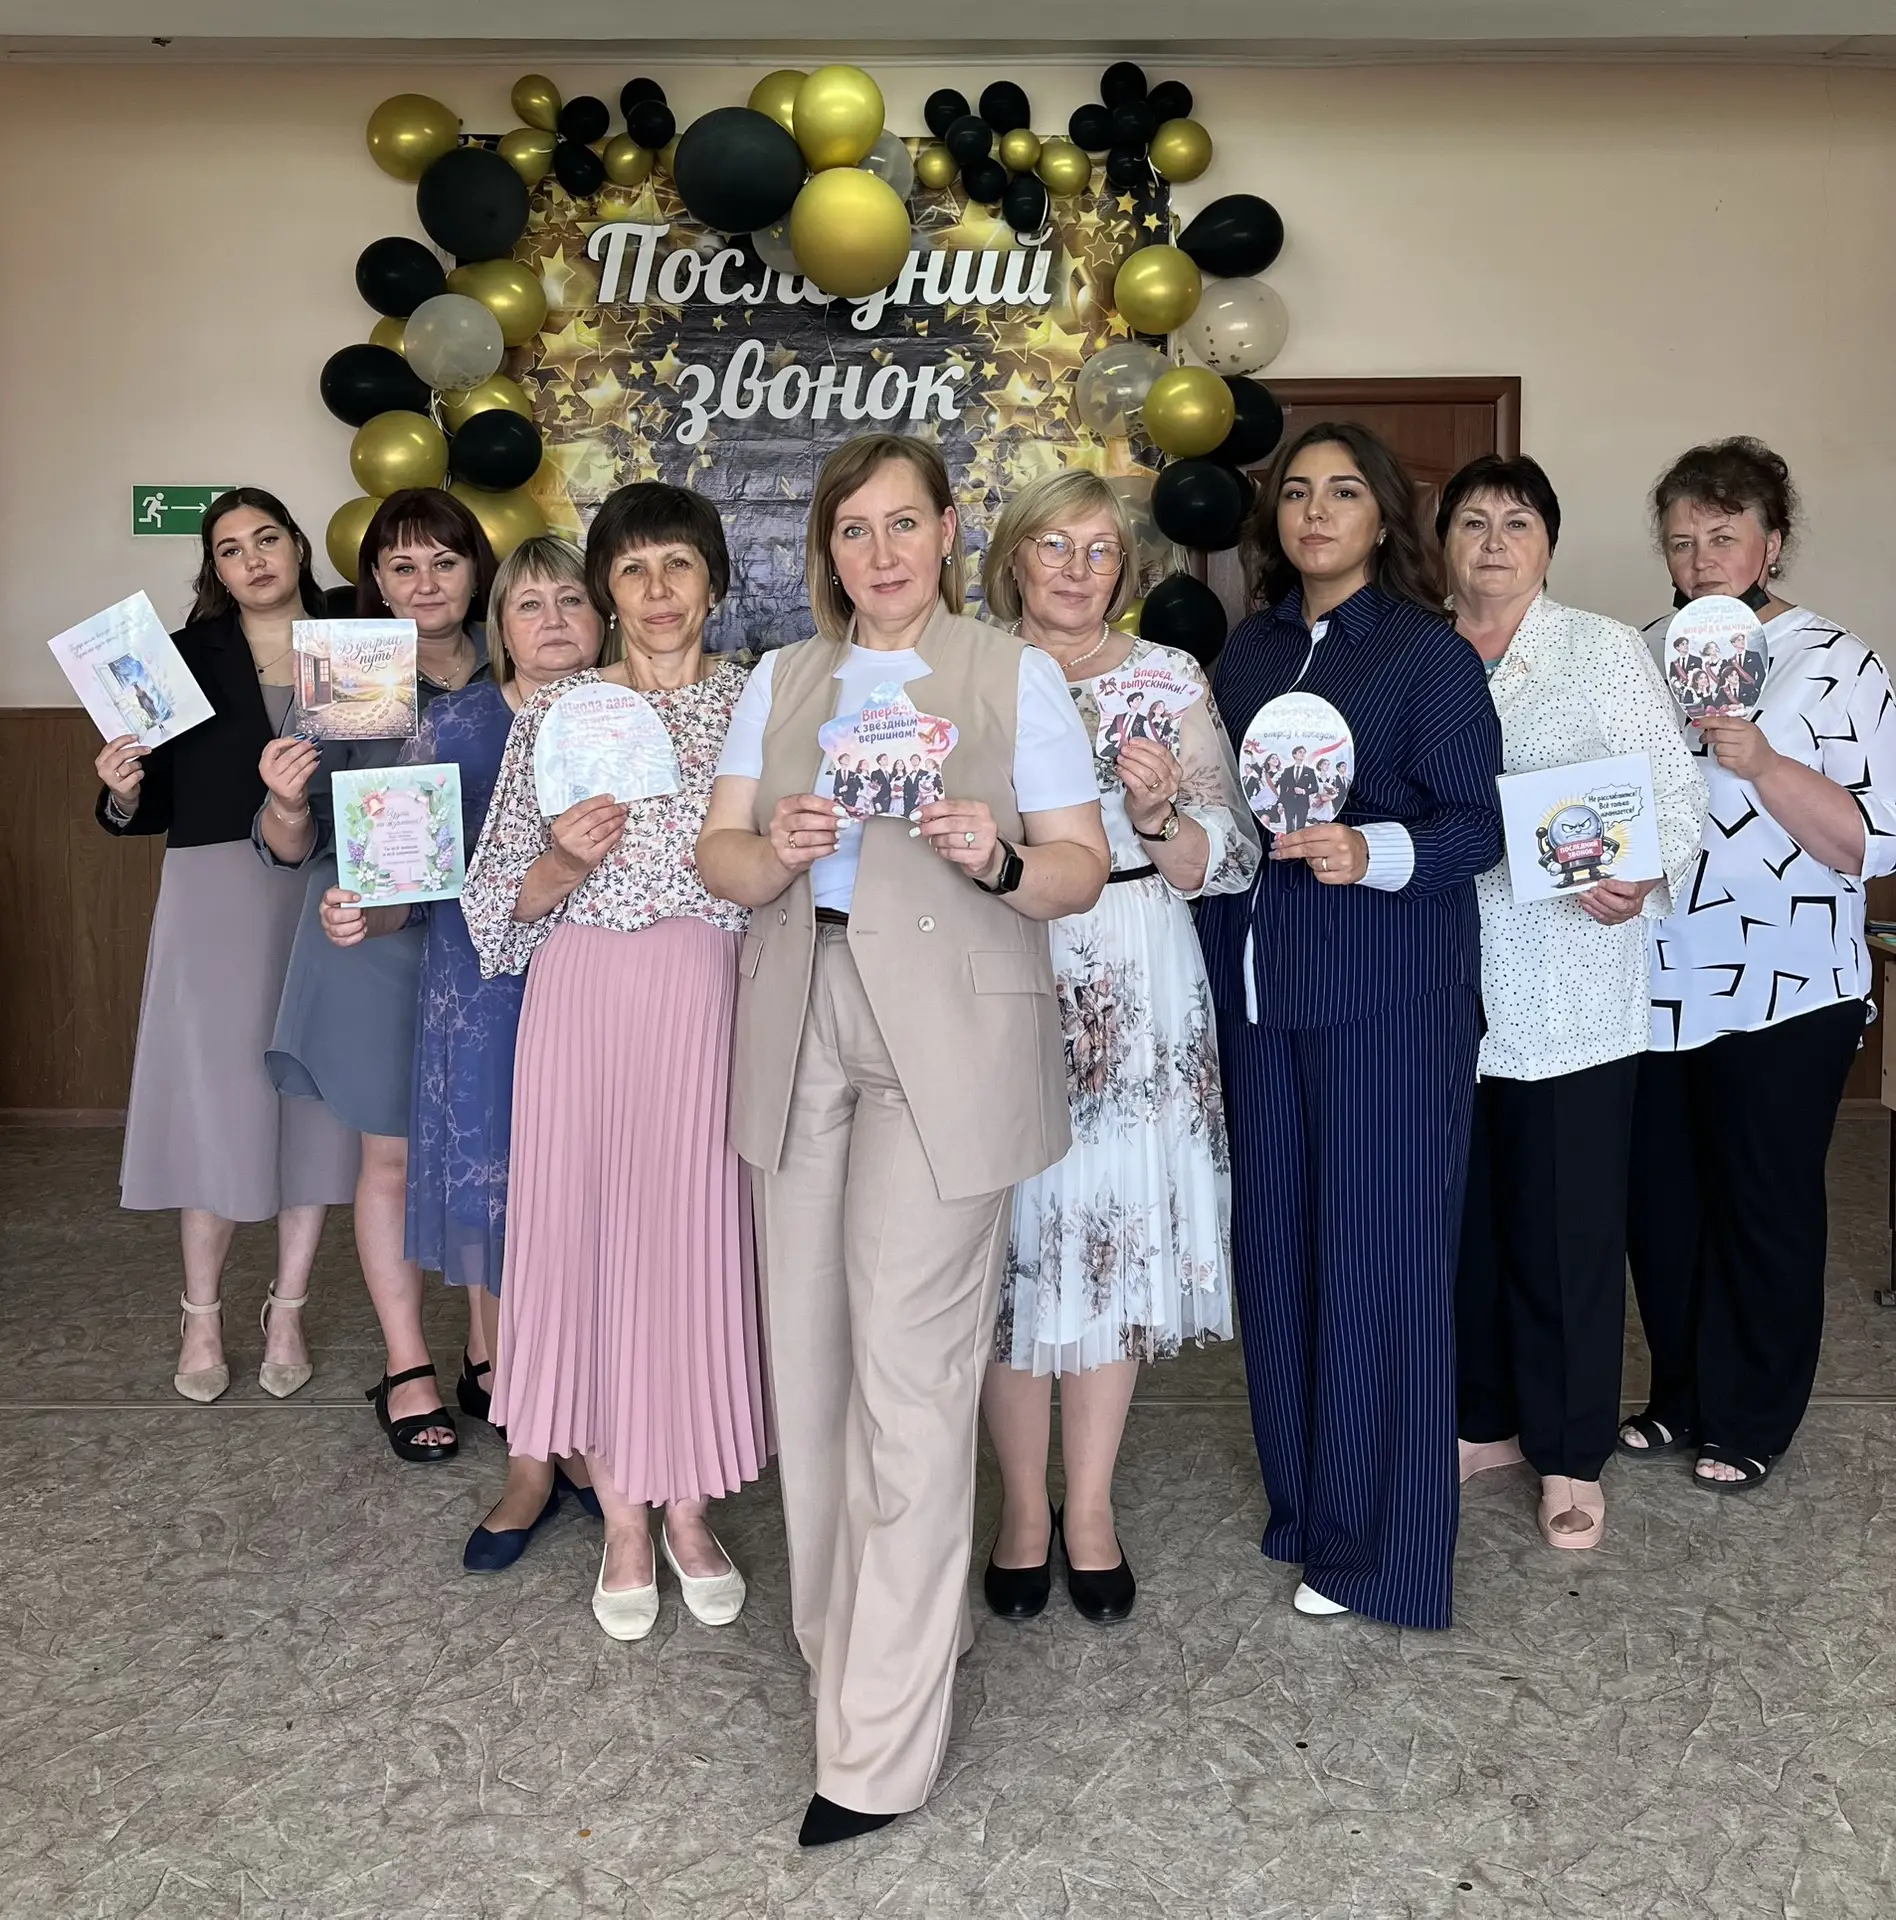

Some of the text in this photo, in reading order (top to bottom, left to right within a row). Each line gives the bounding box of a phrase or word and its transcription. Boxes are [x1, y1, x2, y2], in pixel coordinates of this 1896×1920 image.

[587, 222, 1053, 330] Послний
[674, 339, 965, 445] звонок
[337, 634, 403, 661] В добрый
[359, 645, 397, 674] путь!
[1121, 680, 1188, 695] выпускники!
[606, 696, 636, 711] дала
[853, 725, 860, 734] к
[859, 728, 916, 744] вершинам!
[1560, 841, 1599, 854] ПОСЛЕДНИЙ
[1567, 848, 1594, 859] ЗВОНОК
